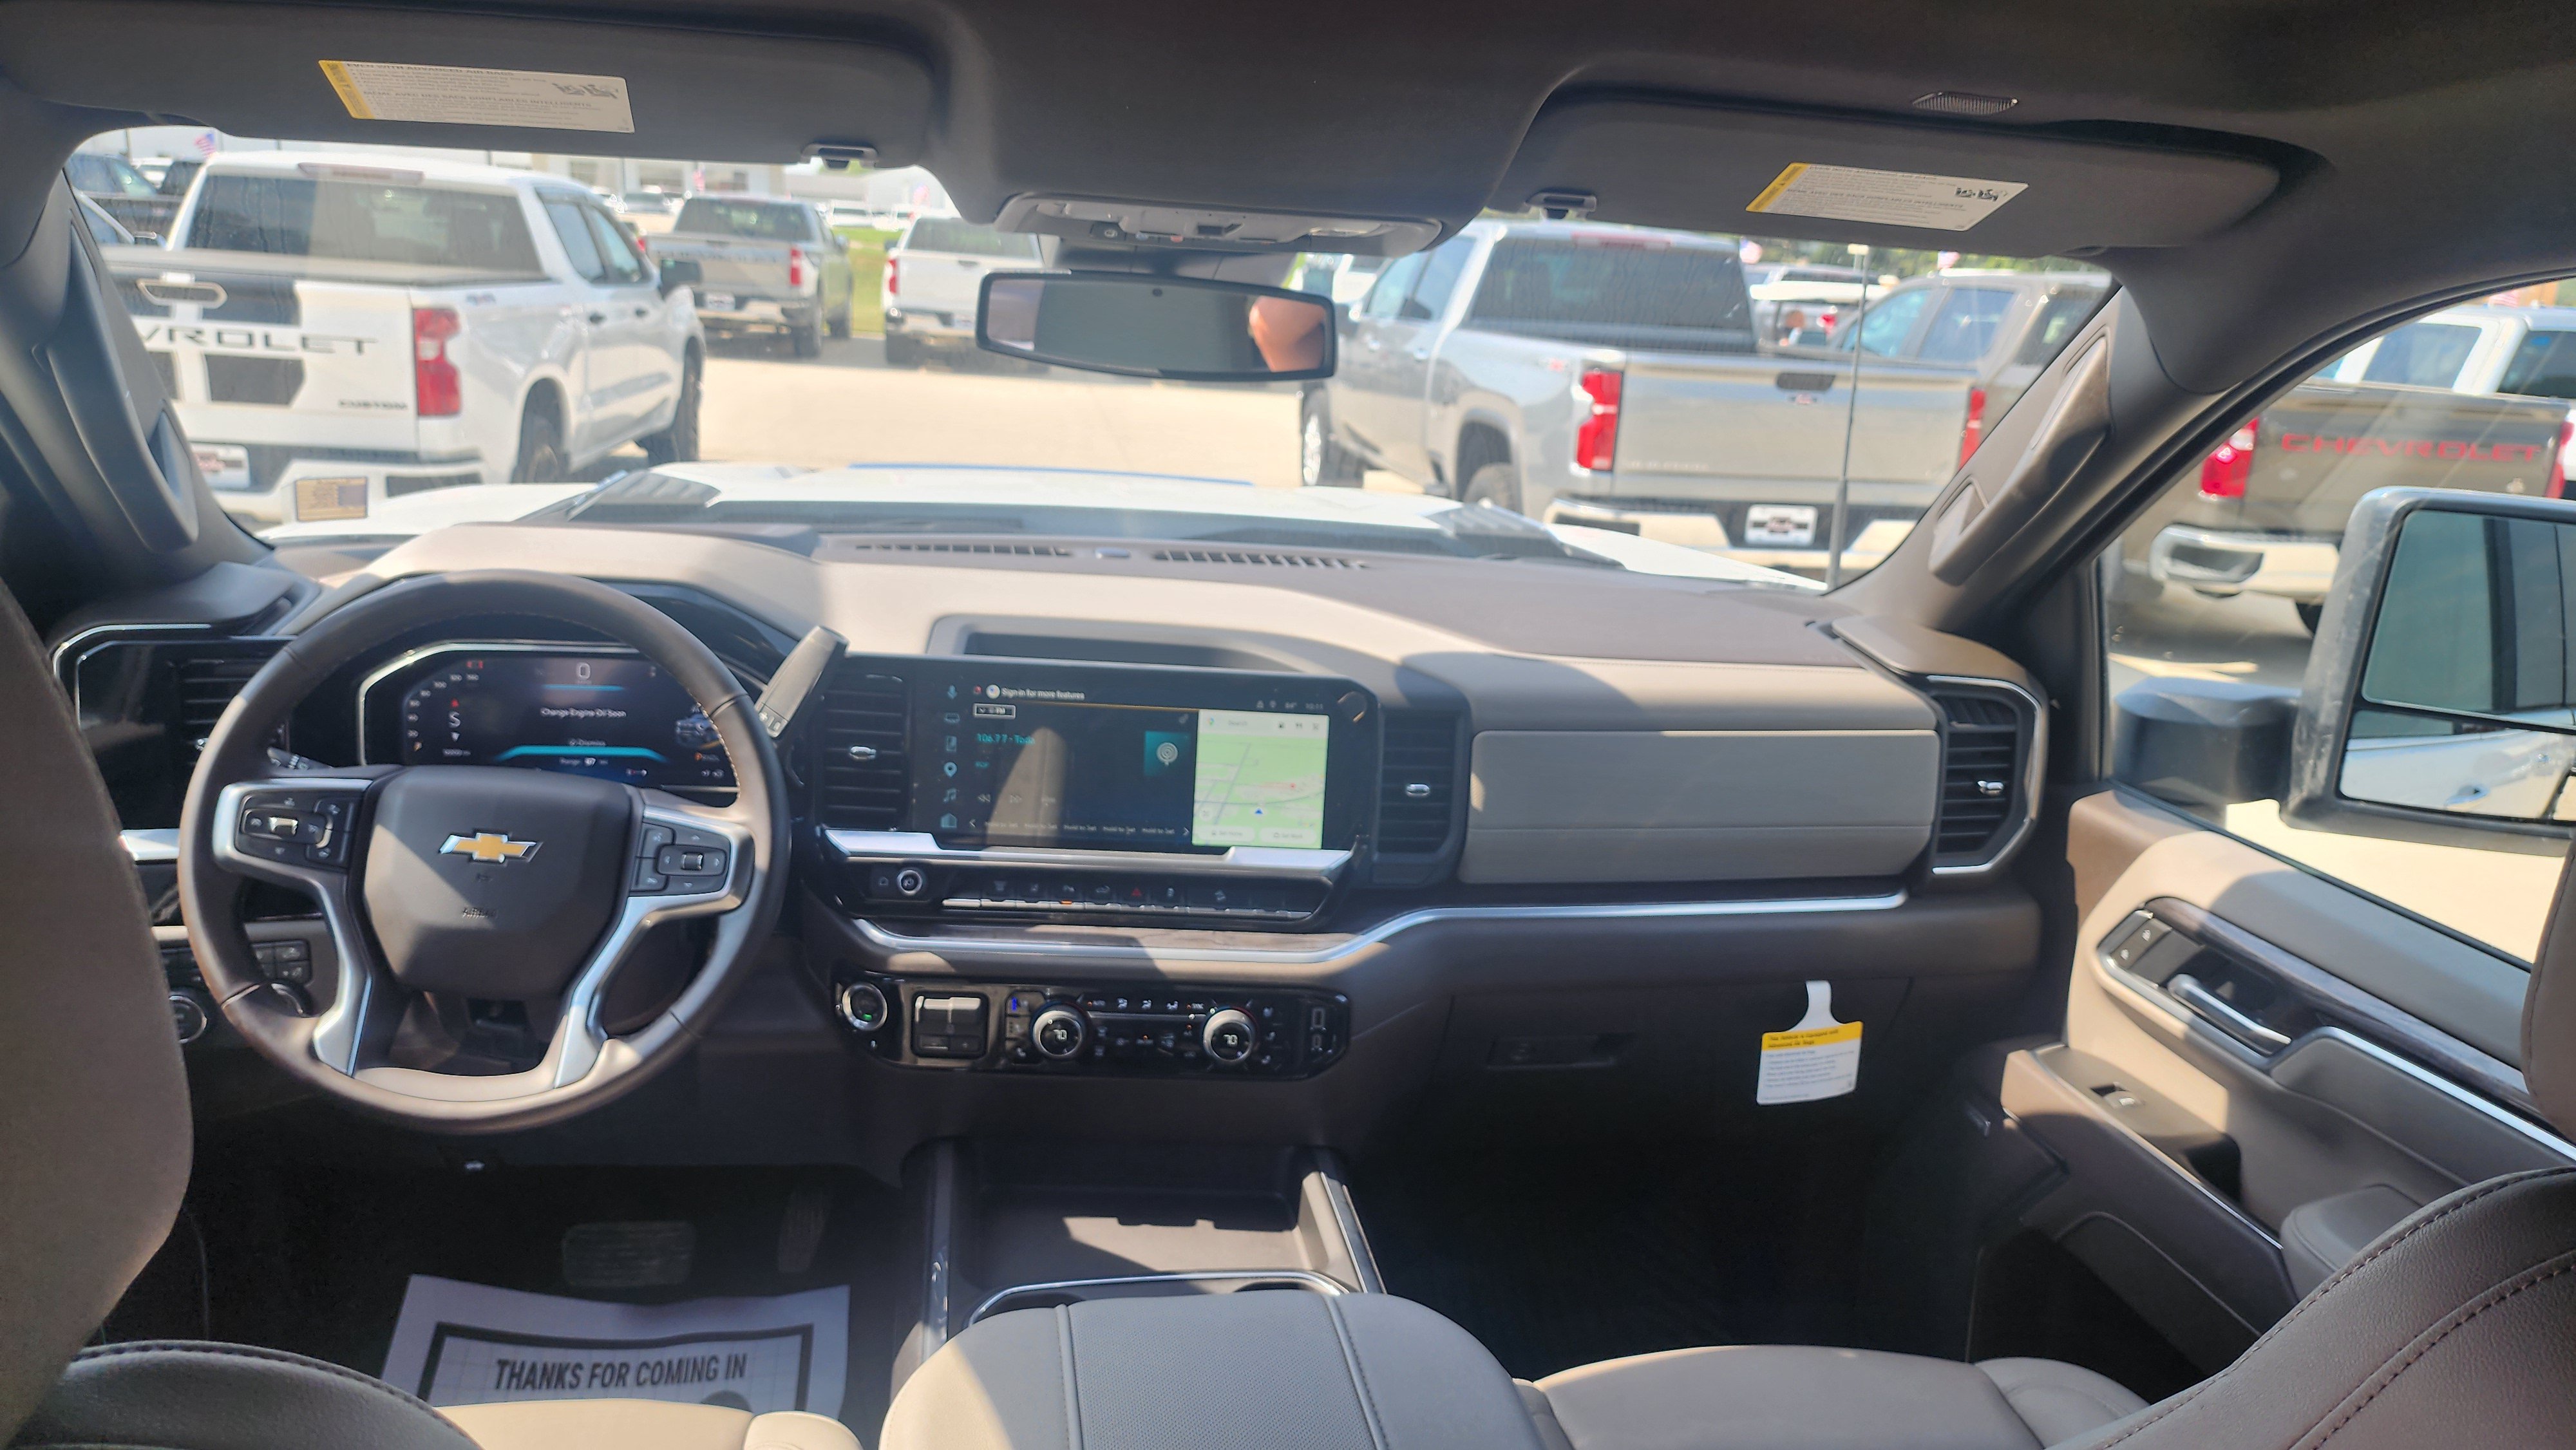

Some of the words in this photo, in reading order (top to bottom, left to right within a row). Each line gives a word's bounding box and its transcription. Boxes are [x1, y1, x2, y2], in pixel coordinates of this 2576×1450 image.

[2280, 433, 2541, 464] CHEVROLET
[576, 662, 591, 681] 0
[1026, 688, 1037, 699] for
[1037, 690, 1056, 699] more
[1056, 690, 1085, 700] features
[448, 711, 461, 728] S
[541, 708, 569, 718] Change
[570, 708, 596, 719] Engine
[596, 708, 607, 717] Oil
[607, 709, 627, 718] Soon
[1053, 1030, 1068, 1040] 70
[1223, 1034, 1238, 1046] 70
[495, 1358, 584, 1390] THANKS
[588, 1361, 629, 1389] FOR
[634, 1354, 719, 1387] COMING
[724, 1353, 747, 1380] IN
